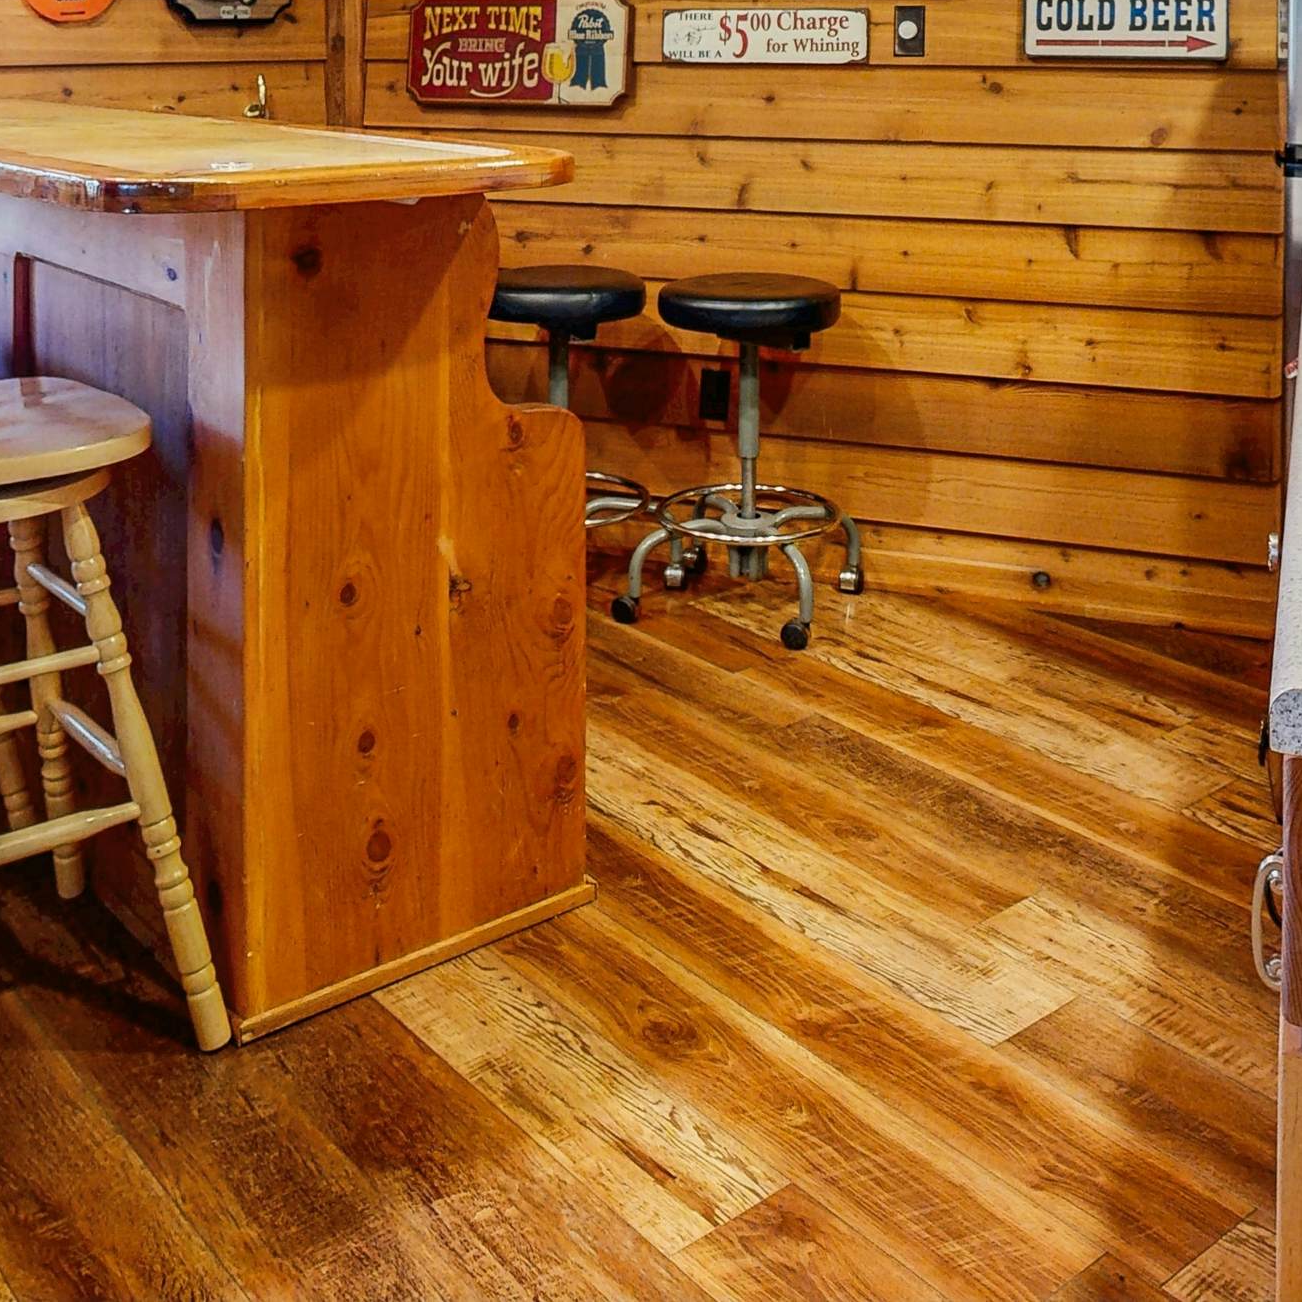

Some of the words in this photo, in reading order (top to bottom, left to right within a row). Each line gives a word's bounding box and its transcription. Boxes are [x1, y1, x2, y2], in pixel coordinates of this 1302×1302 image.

[424, 6, 480, 41] NEXT
[486, 6, 542, 42] TIME
[577, 14, 604, 29] Pabst
[679, 13, 714, 21] THERE
[777, 11, 849, 38] Charge
[569, 29, 585, 40] Blue
[586, 29, 613, 40] Ribbon
[458, 37, 506, 52] BRING
[767, 38, 789, 53] for
[793, 38, 859, 58] Whining
[668, 50, 694, 59] WILL
[698, 50, 711, 58] BE
[714, 49, 723, 58] A
[470, 42, 539, 98] wife
